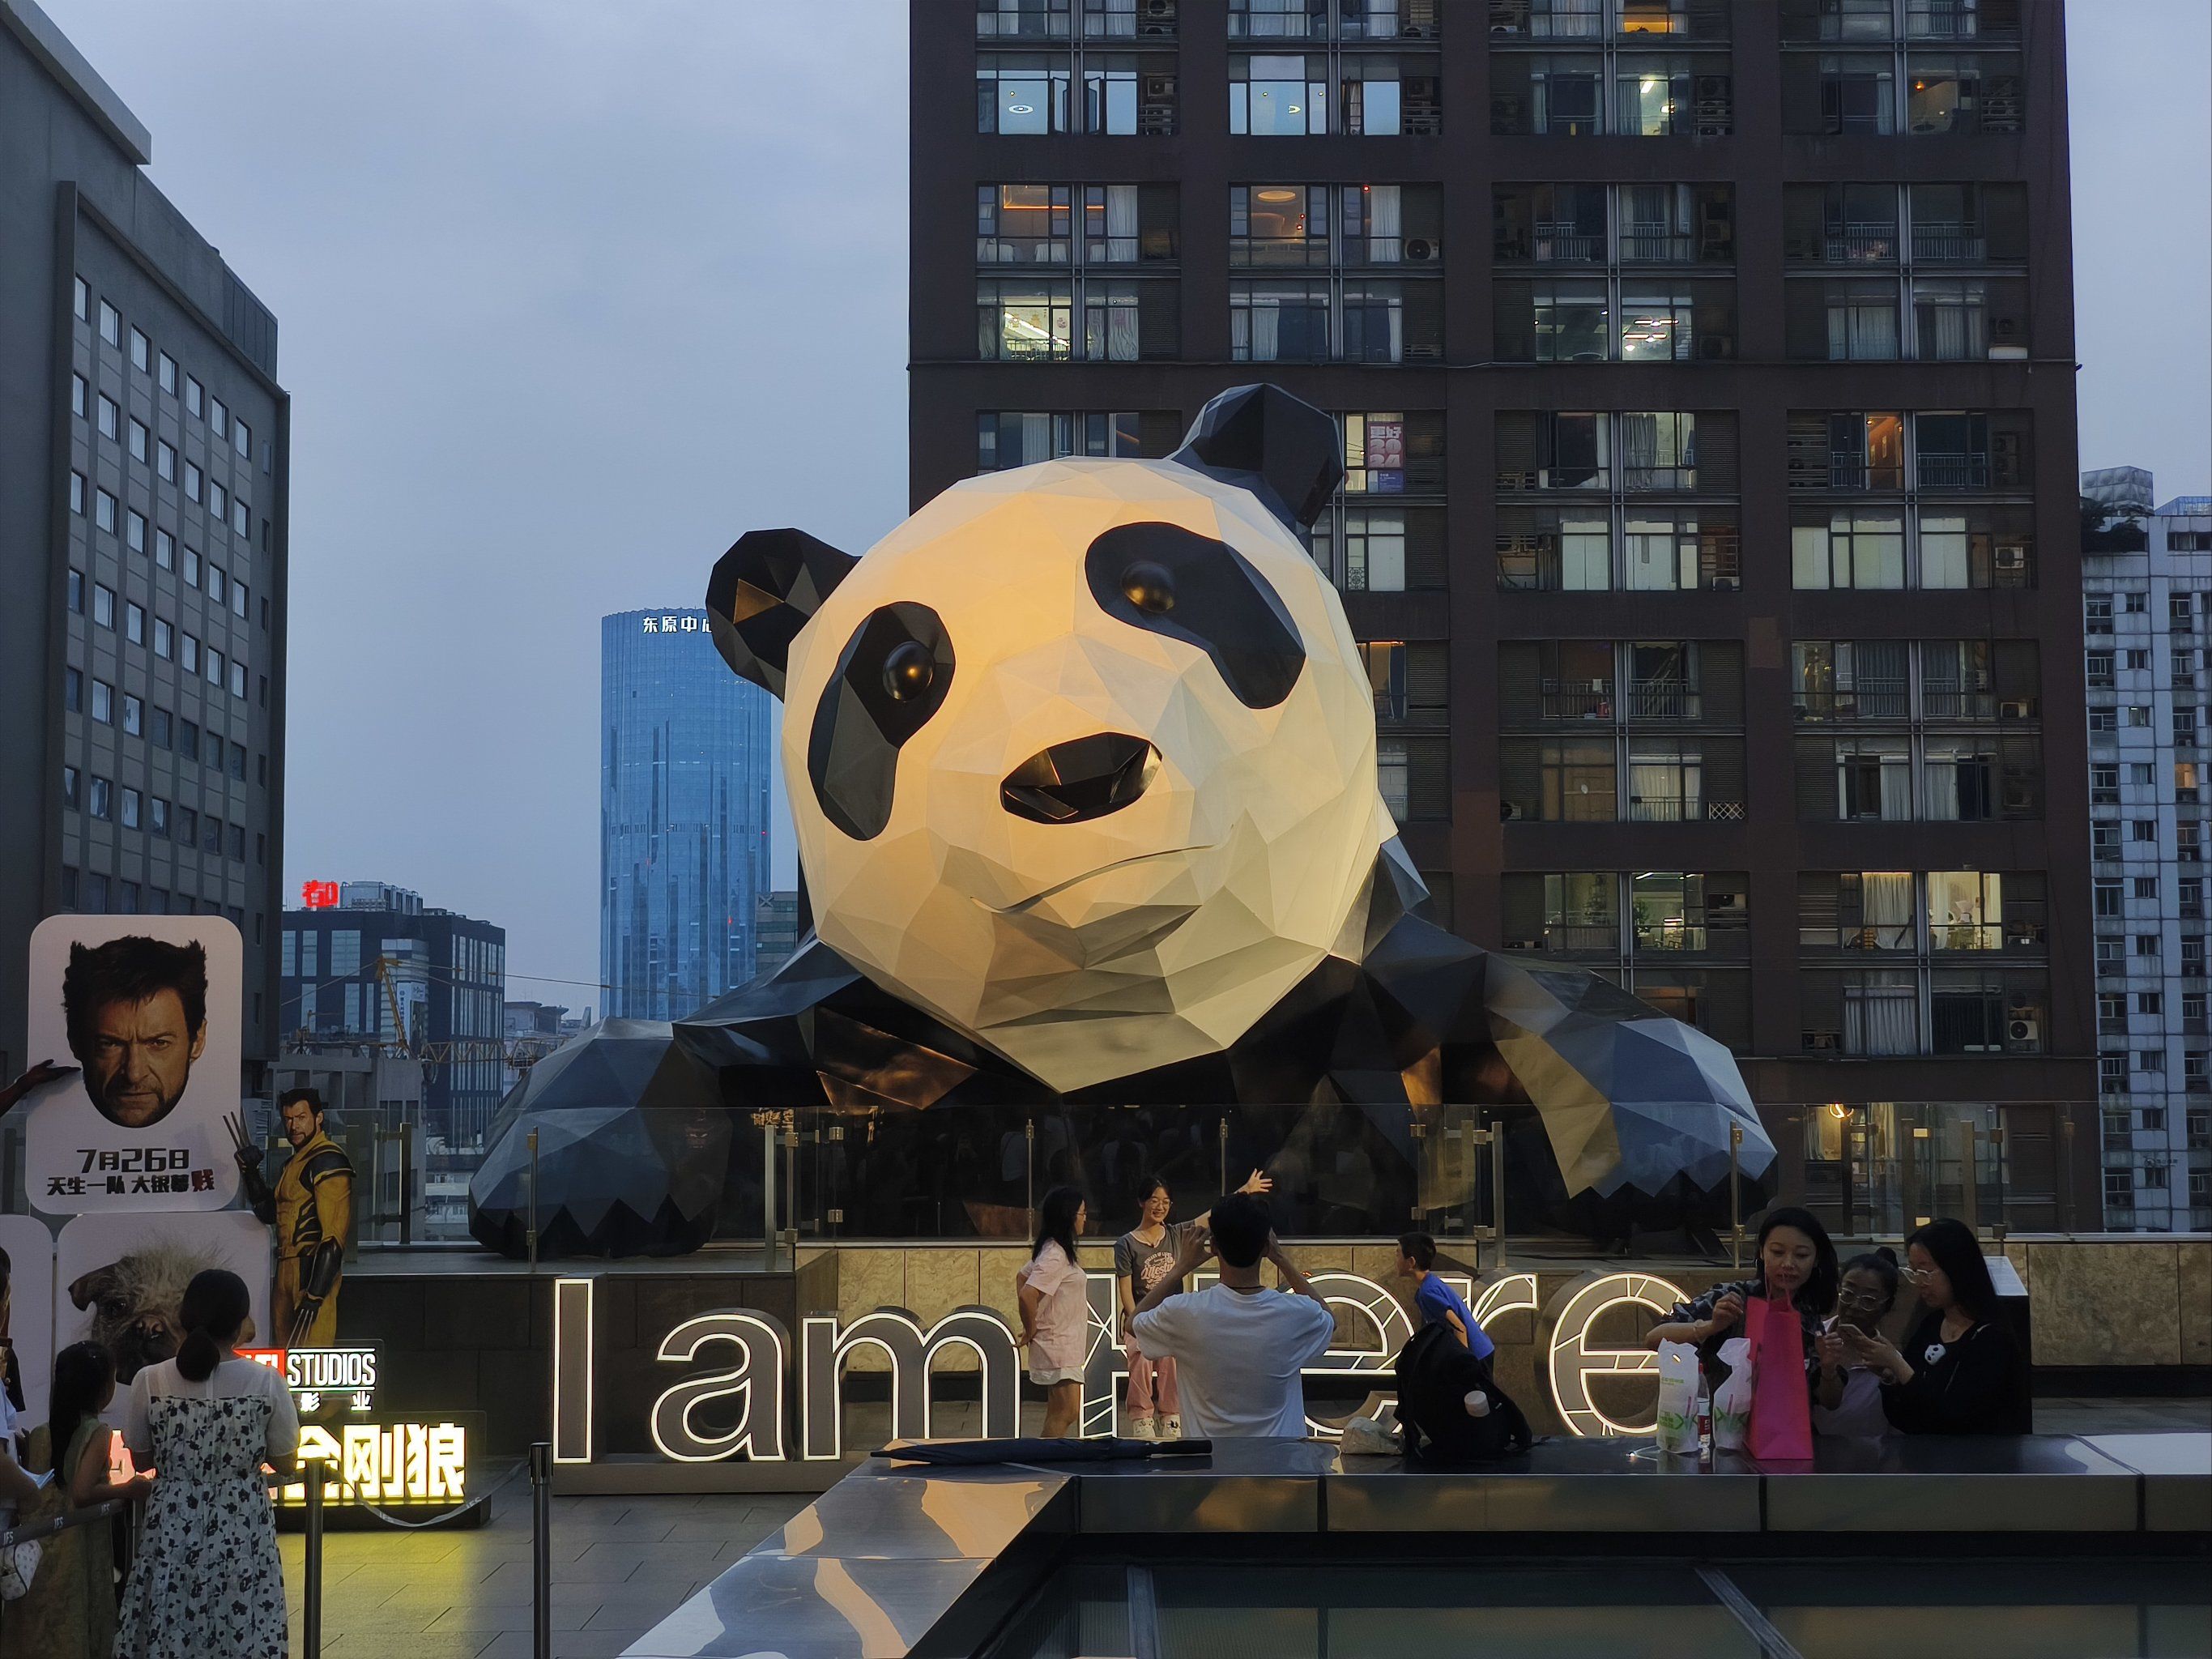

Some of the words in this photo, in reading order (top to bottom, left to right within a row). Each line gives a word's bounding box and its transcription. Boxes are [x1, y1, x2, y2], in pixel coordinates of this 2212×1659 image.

[1370, 425, 1401, 439] 更好
[1370, 438, 1402, 454] 20
[1370, 454, 1401, 468] 24
[76, 1148, 190, 1174] 7月26日
[47, 1175, 126, 1196] 天生一队
[287, 1354, 376, 1386] STUDIOS
[554, 1277, 594, 1464] I
[651, 1310, 1021, 1463] am
[53, 1516, 64, 1530] IFS
[3, 1531, 14, 1546] IFS
